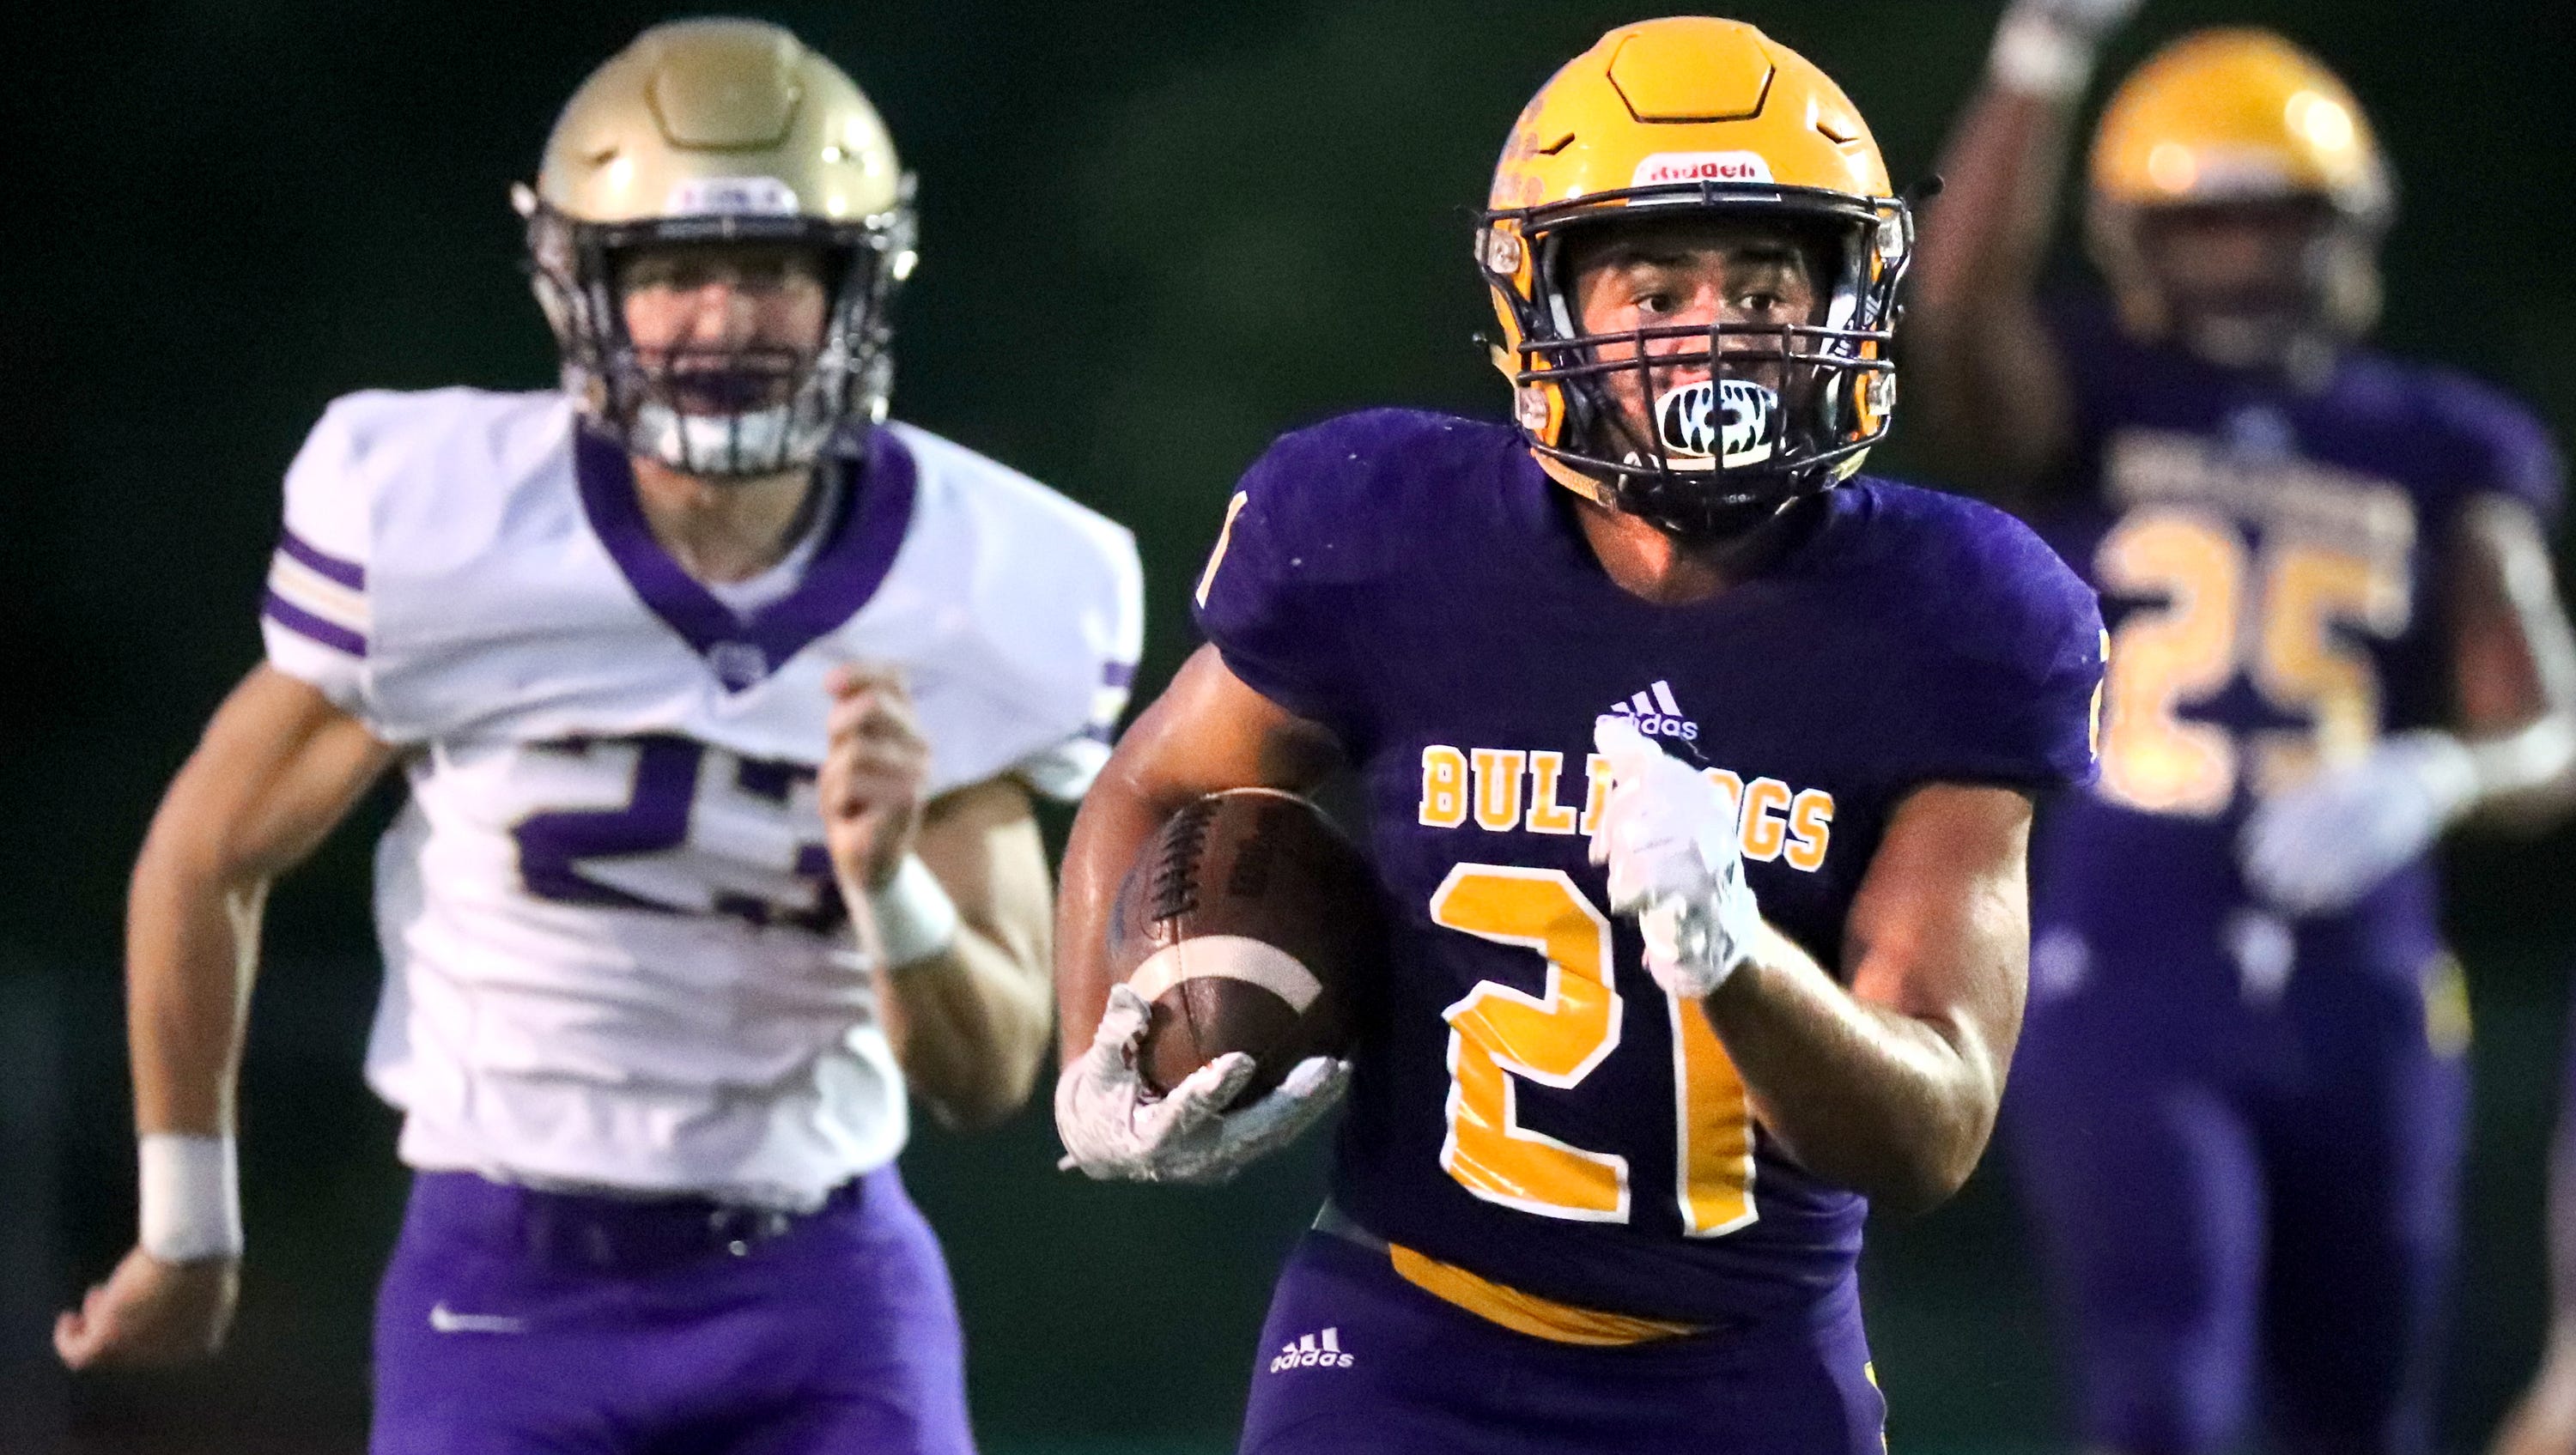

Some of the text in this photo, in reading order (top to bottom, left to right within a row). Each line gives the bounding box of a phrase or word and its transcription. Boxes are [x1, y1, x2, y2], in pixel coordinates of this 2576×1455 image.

[2092, 508, 2413, 811] 25
[1429, 861, 1760, 1239] 21
[1270, 1348, 1355, 1373] adidas
